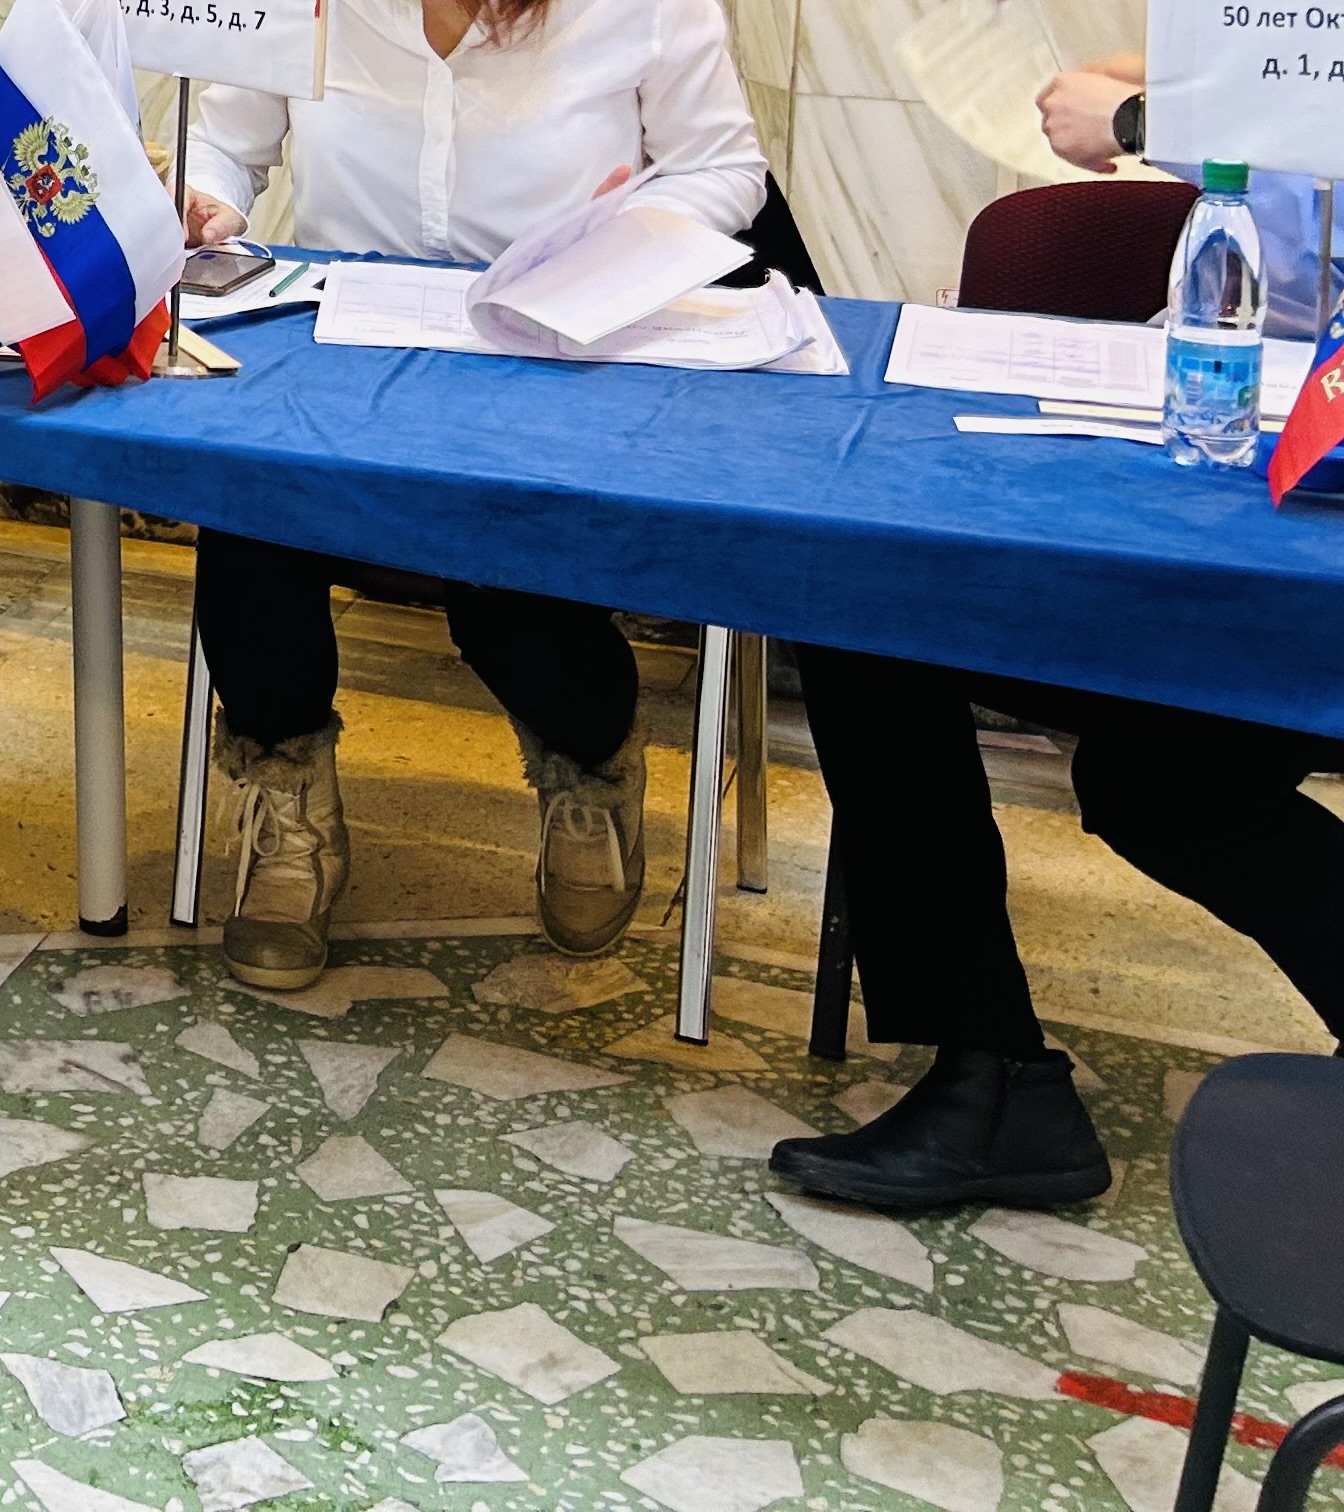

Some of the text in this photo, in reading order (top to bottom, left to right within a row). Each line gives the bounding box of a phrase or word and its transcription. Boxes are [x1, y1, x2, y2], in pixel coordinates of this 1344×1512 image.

[181, 5, 200, 24] д.
[206, 3, 223, 28] 5,
[229, 11, 247, 32] д.
[254, 10, 266, 30] 7
[1223, 5, 1344, 29] 50 лет Ок
[1262, 58, 1288, 80] д.
[1298, 53, 1320, 81] 1,
